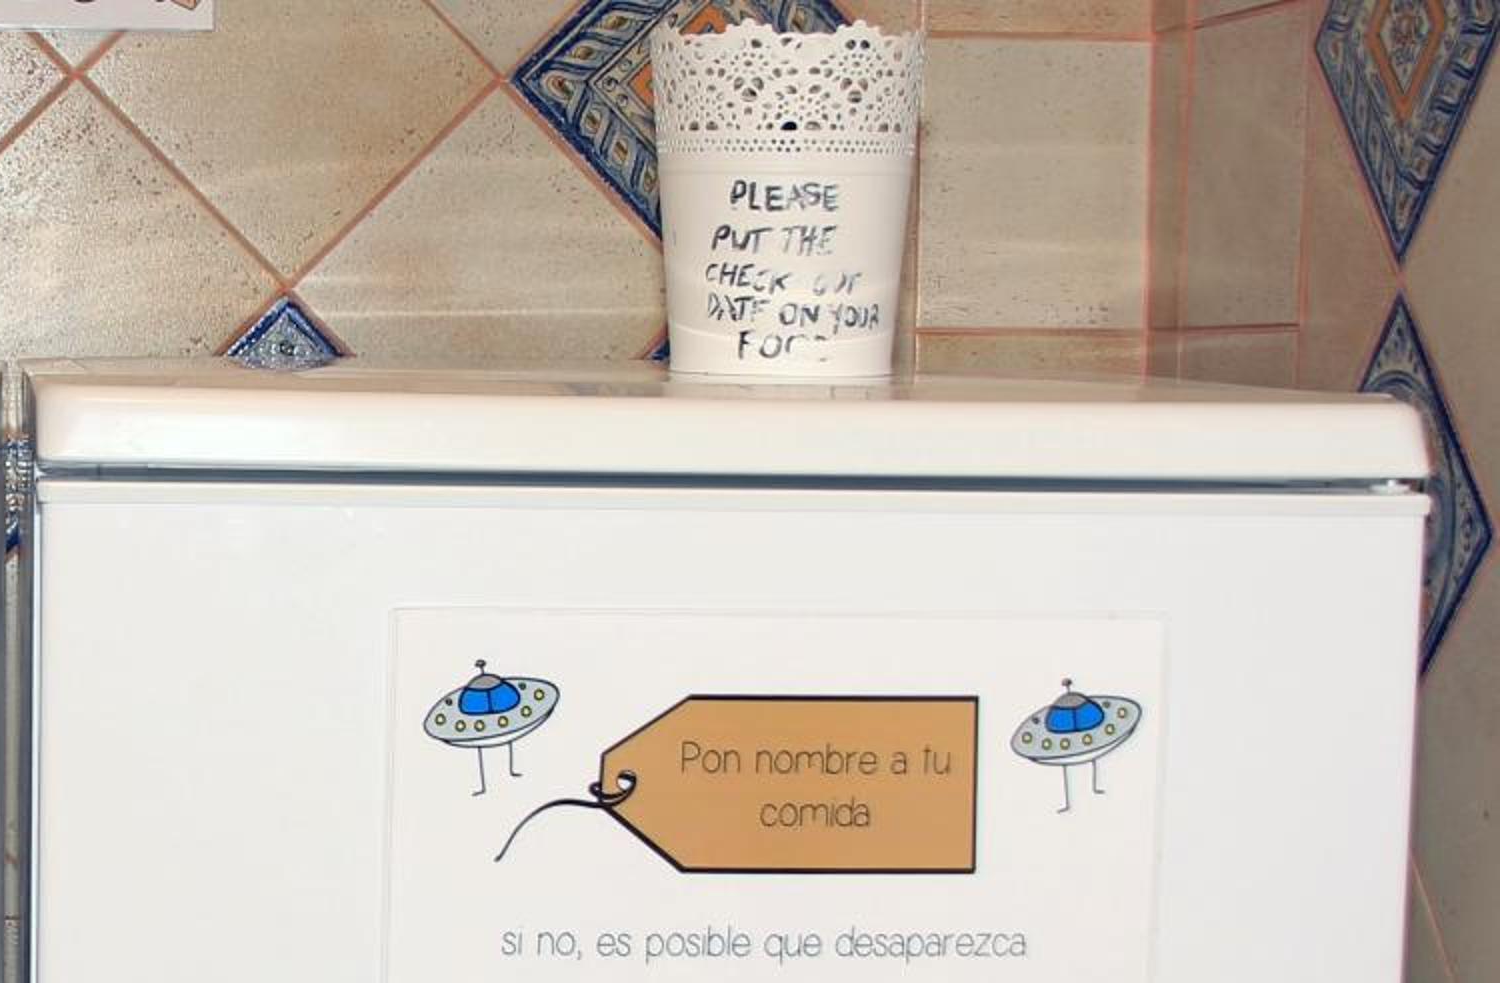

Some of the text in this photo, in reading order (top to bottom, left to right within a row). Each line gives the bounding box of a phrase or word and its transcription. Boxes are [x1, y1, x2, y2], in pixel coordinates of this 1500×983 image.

[730, 180, 839, 211] PLEASE
[711, 224, 838, 256] PUT THE
[705, 263, 792, 292] CHECK
[707, 292, 770, 321] DATE
[778, 303, 819, 327] ON
[680, 741, 952, 776] Pon nombre a tu
[759, 798, 871, 829] comida
[501, 924, 1027, 965] si no, es posible que desaparezca
